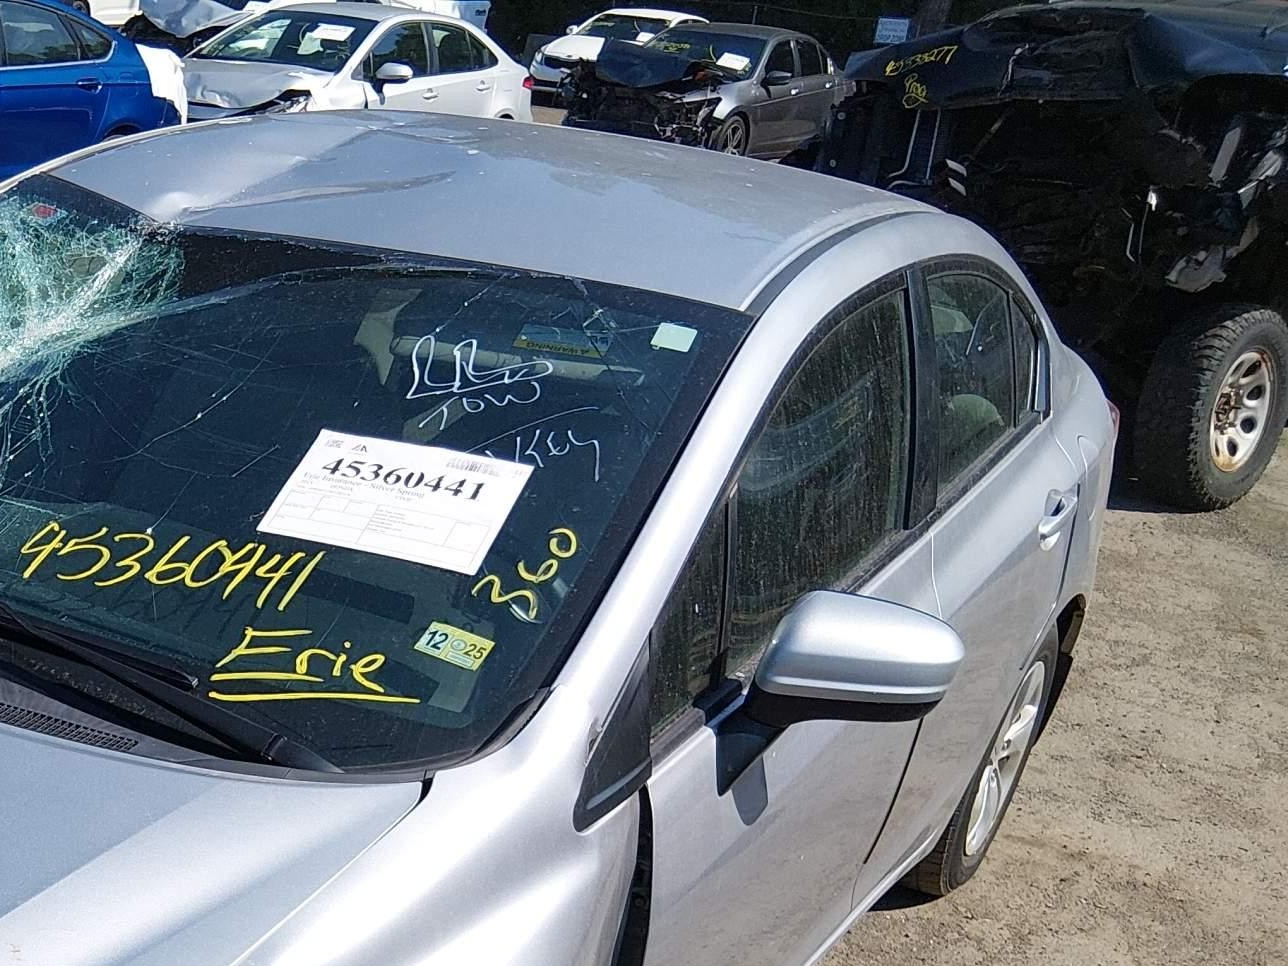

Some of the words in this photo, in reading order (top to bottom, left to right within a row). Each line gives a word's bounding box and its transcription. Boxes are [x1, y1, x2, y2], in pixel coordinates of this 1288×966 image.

[322, 457, 485, 500] 45360441
[471, 527, 578, 619] 360
[215, 626, 386, 693] Erie
[425, 630, 449, 651] 12
[463, 643, 487, 660] 25
